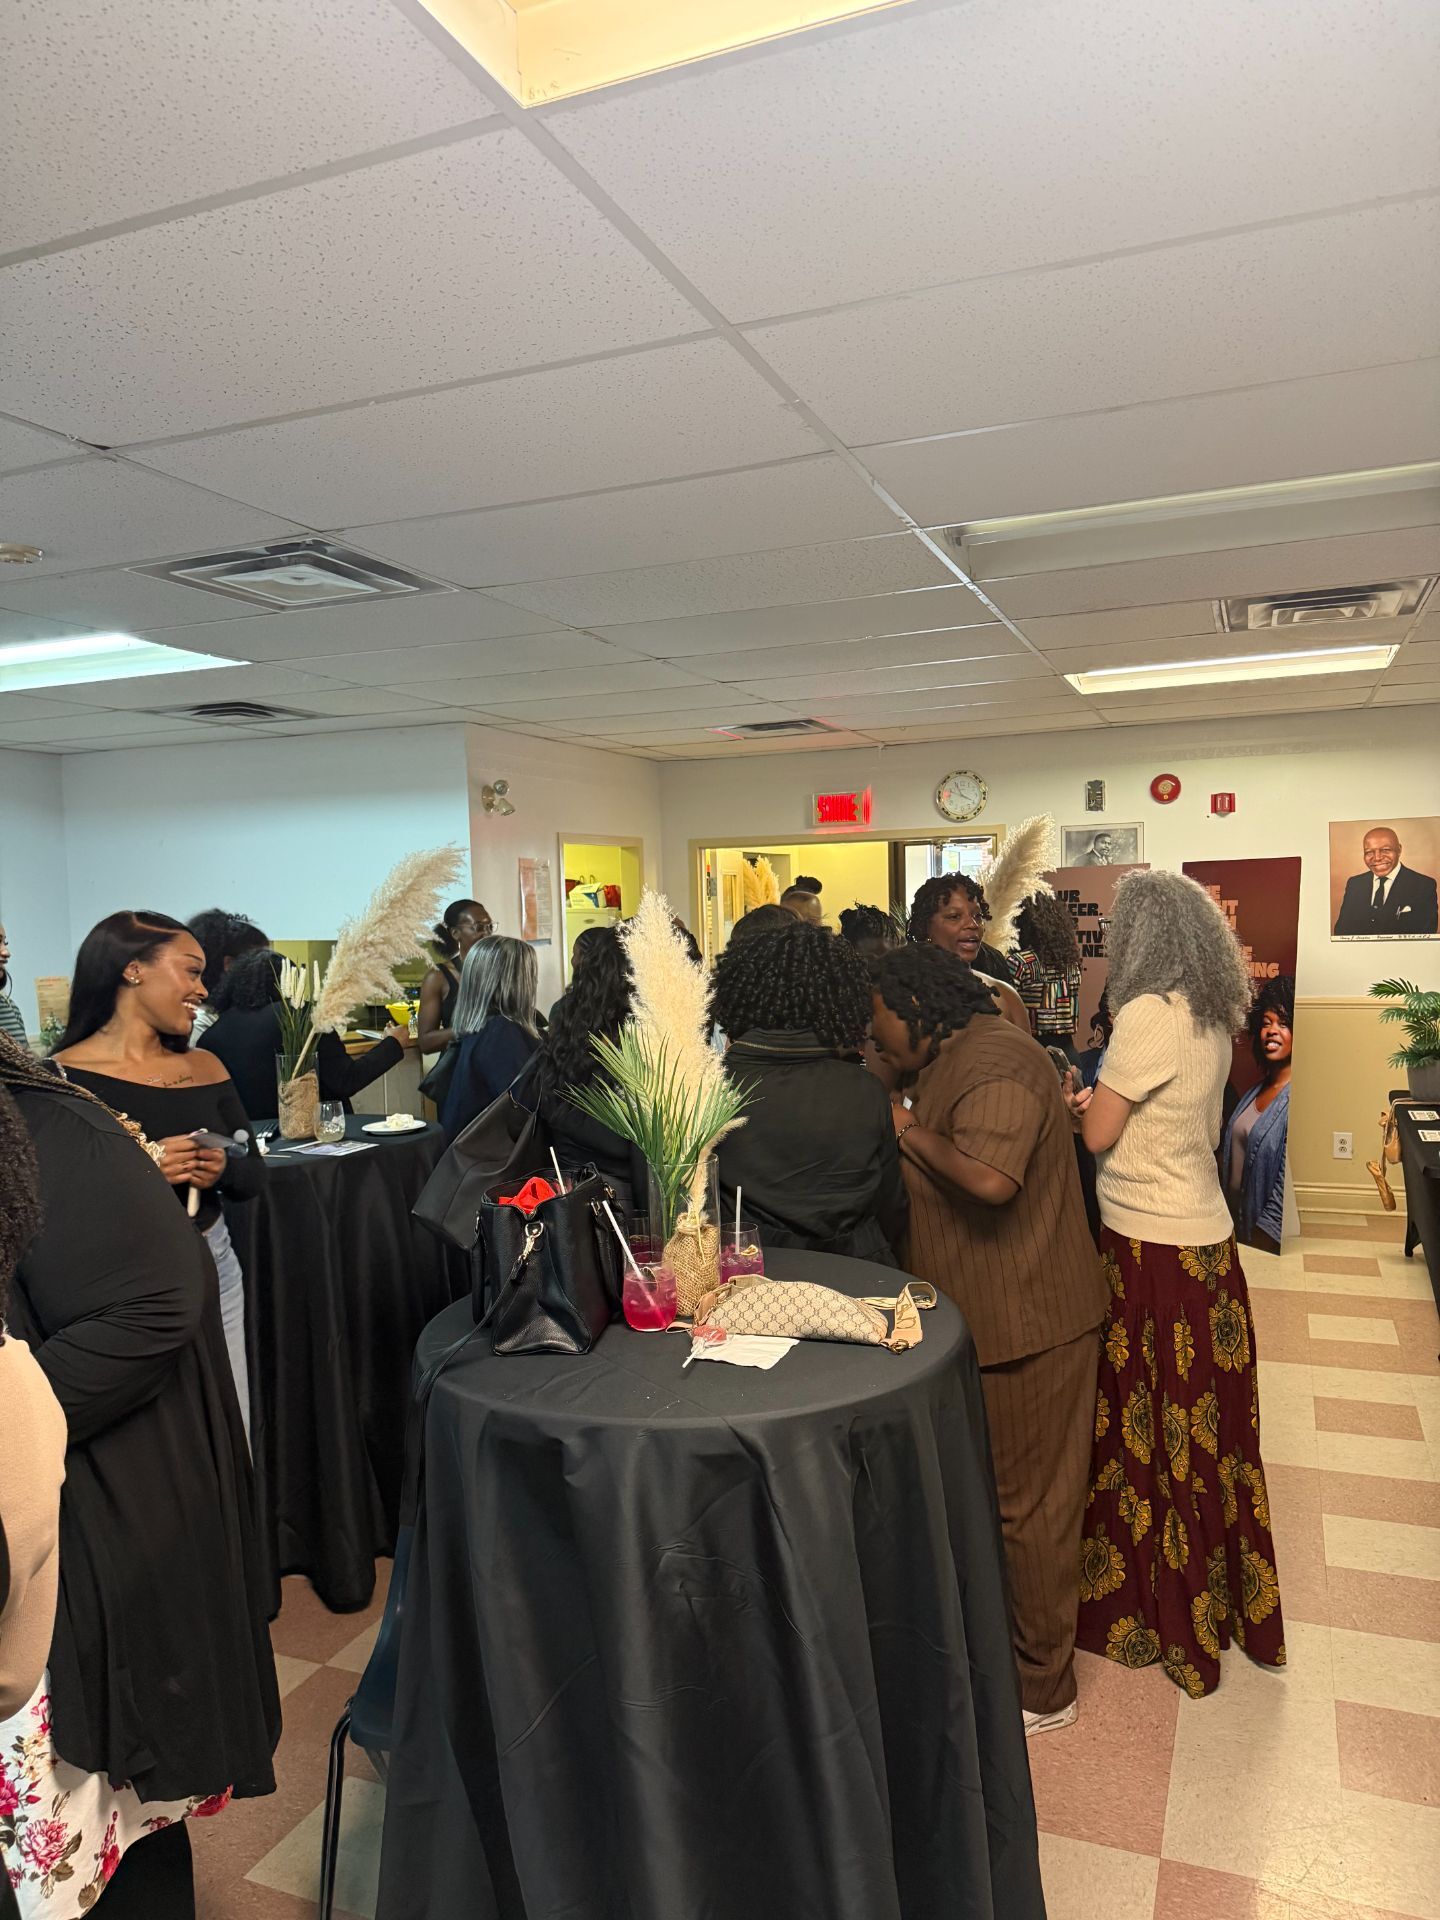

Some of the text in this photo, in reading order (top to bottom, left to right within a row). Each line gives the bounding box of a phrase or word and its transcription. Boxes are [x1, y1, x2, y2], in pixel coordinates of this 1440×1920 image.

[1057, 890, 1081, 903] UR
[1068, 902, 1103, 917] EER.
[1076, 930, 1104, 943] TIV
[1249, 961, 1280, 978] ING
